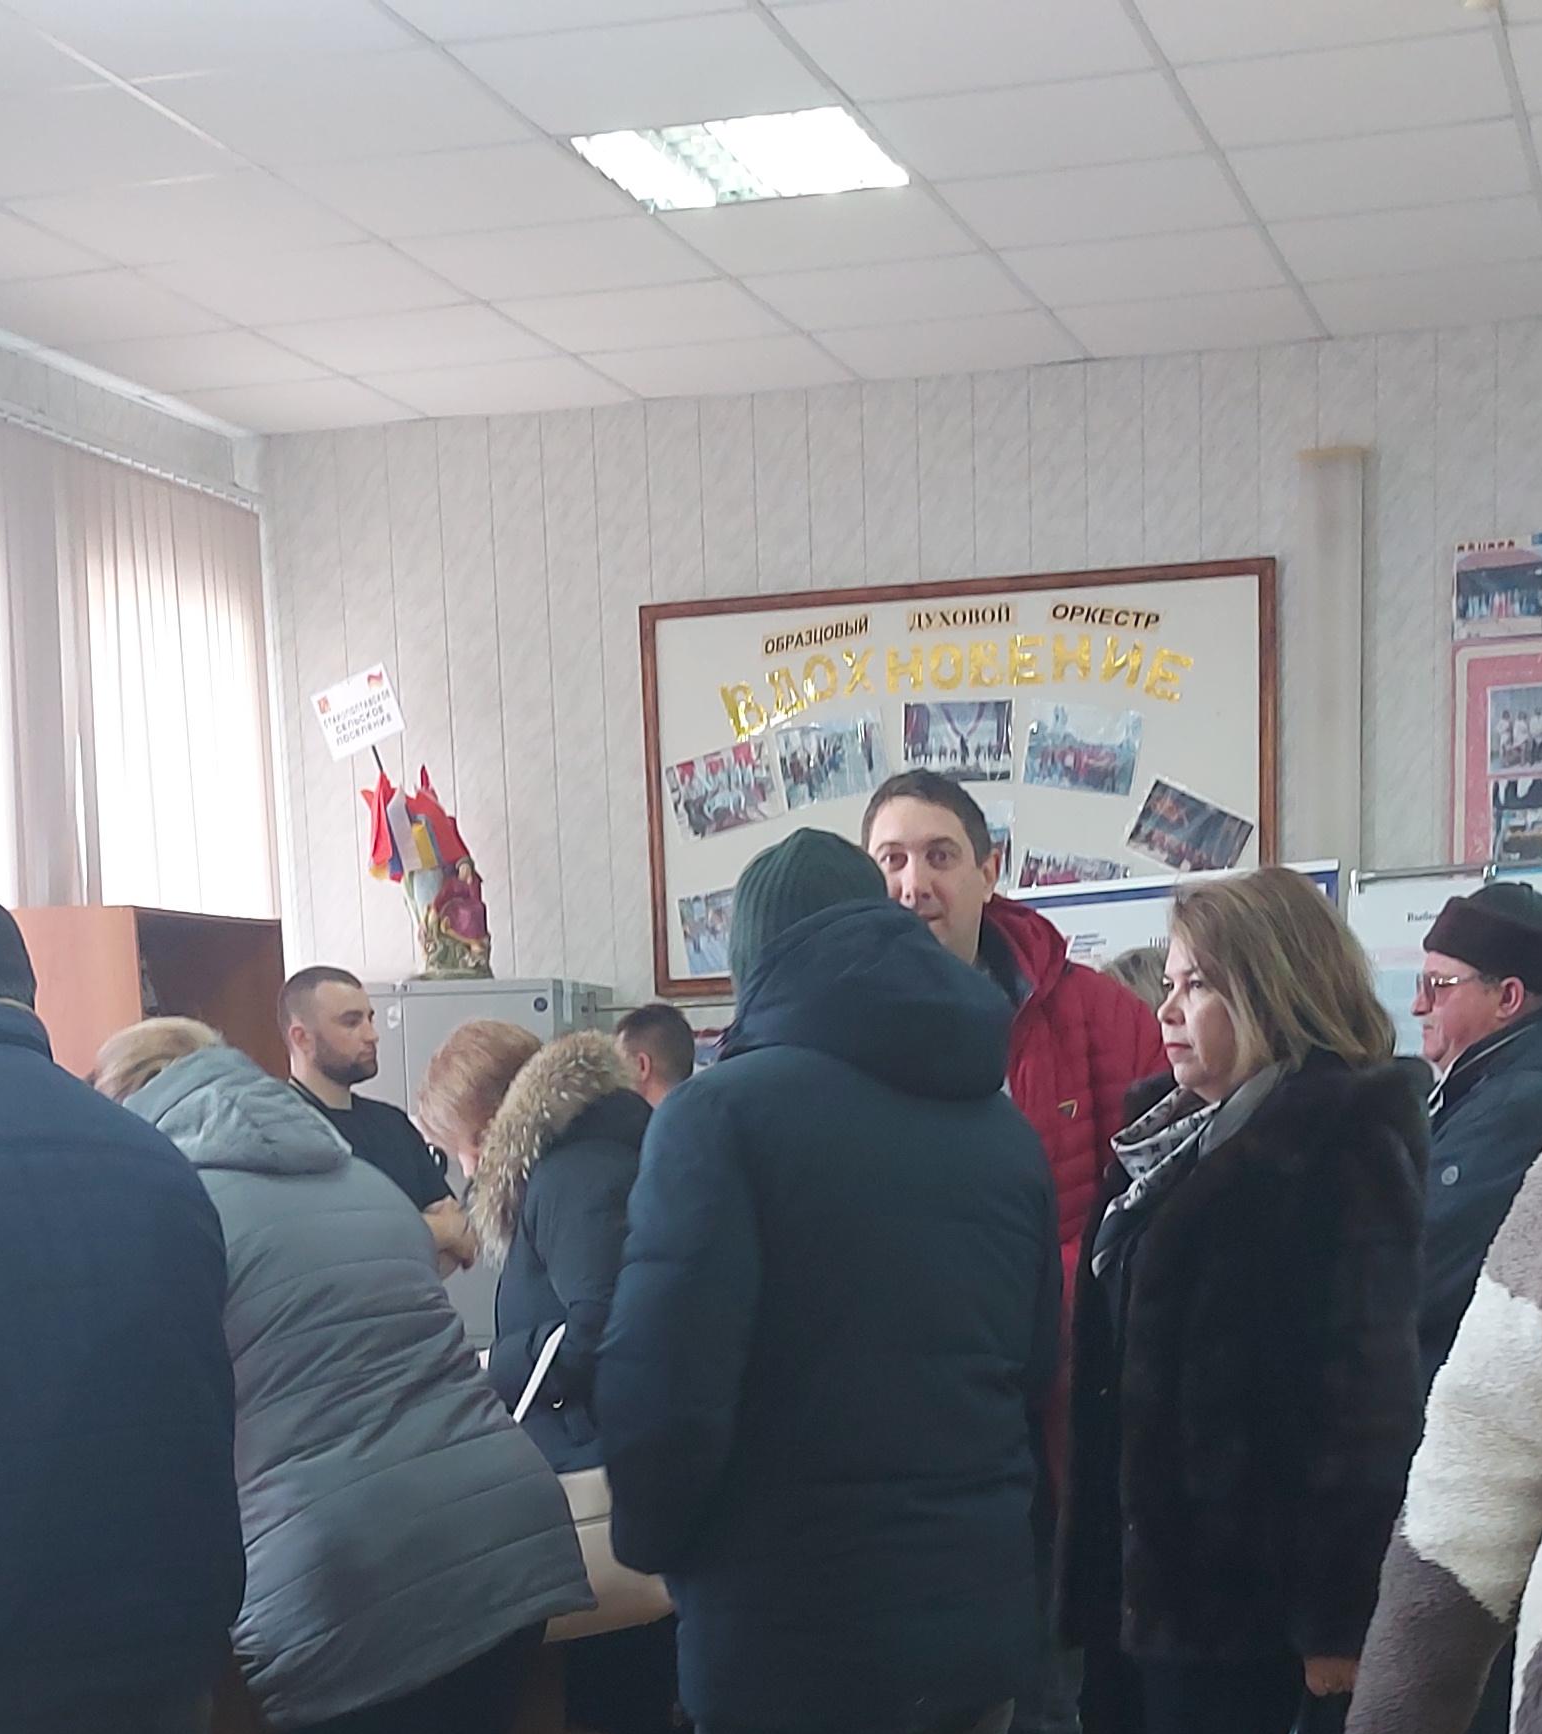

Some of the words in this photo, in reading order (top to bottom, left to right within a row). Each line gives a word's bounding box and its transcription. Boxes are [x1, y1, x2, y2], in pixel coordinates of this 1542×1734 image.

[765, 614, 869, 655] ОБРАЗЦОВЫЙ
[909, 602, 1010, 632] ДУХОВОЙ
[1051, 603, 1160, 630] ОРКЕСТР
[719, 633, 1194, 742] ВДОХНОВЕНИЕ
